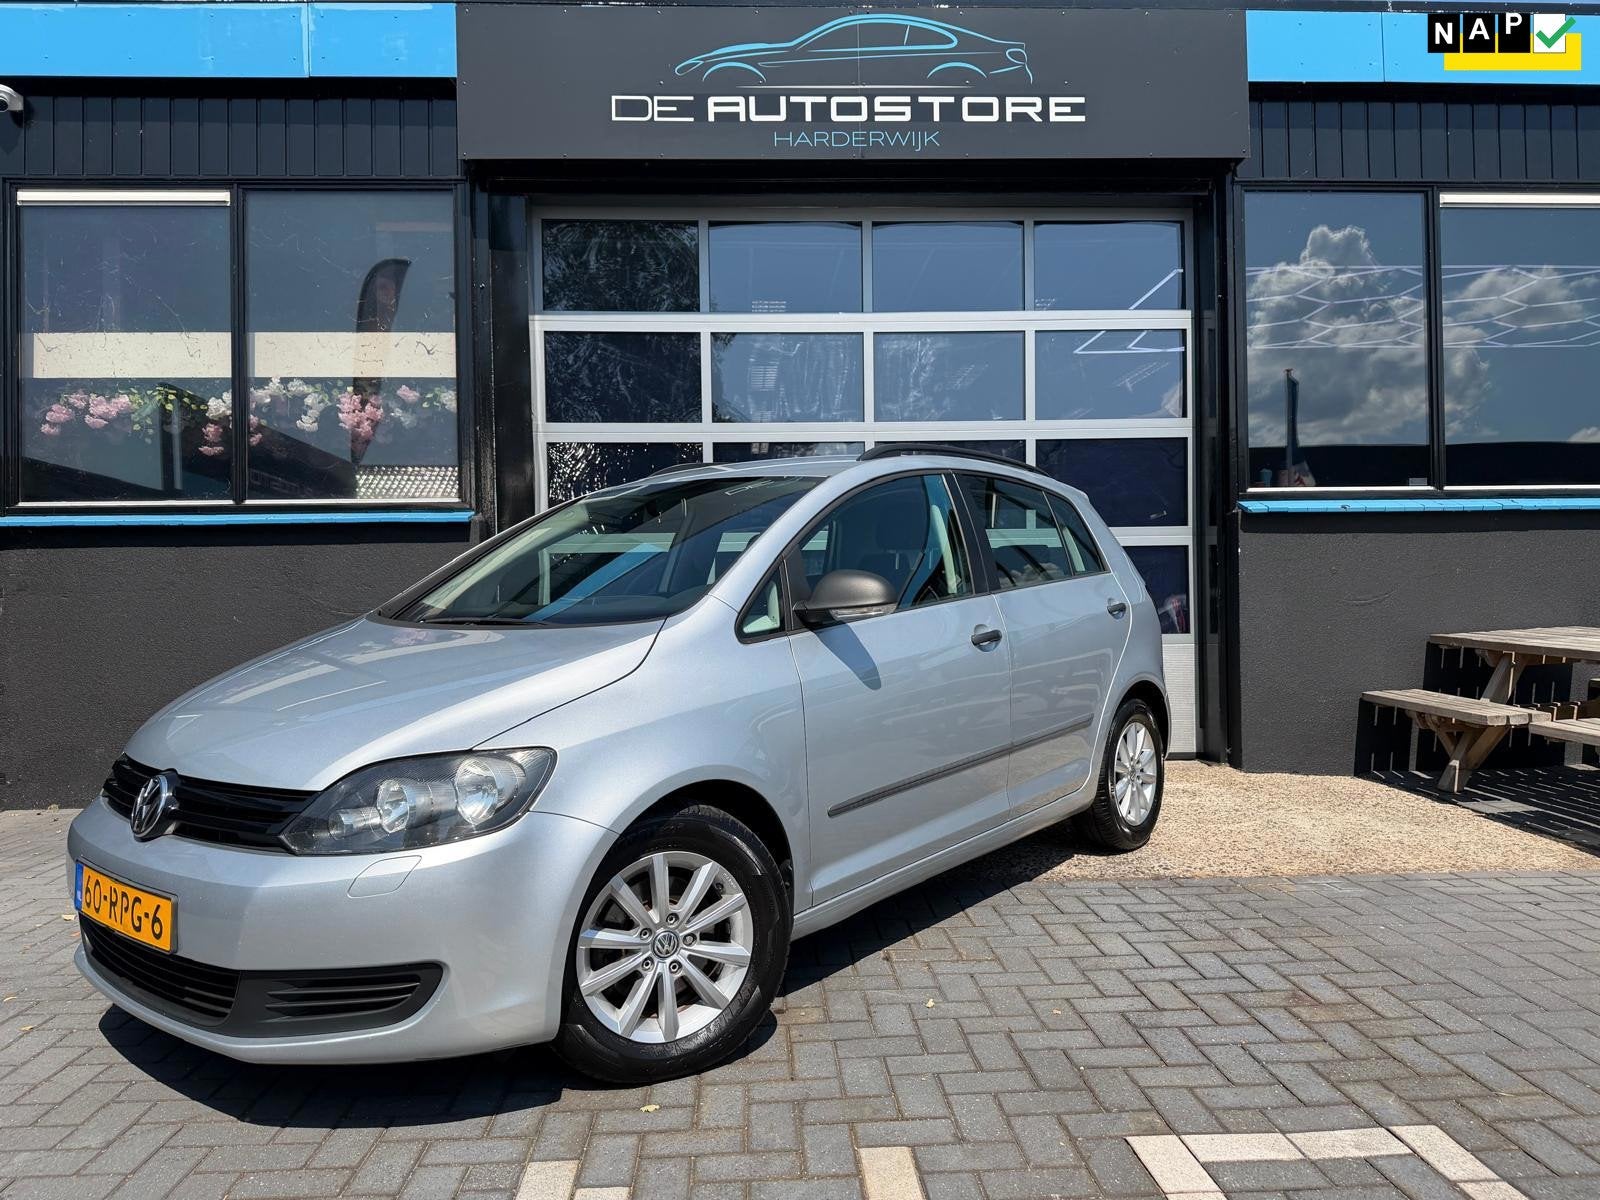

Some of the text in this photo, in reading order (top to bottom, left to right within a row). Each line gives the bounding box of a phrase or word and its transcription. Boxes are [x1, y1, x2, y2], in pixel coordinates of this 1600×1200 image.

[611, 94, 1086, 122] DE AUTOSTORE
[773, 130, 941, 152] HARDERWIJK
[83, 874, 164, 941] 60-RPG-6
